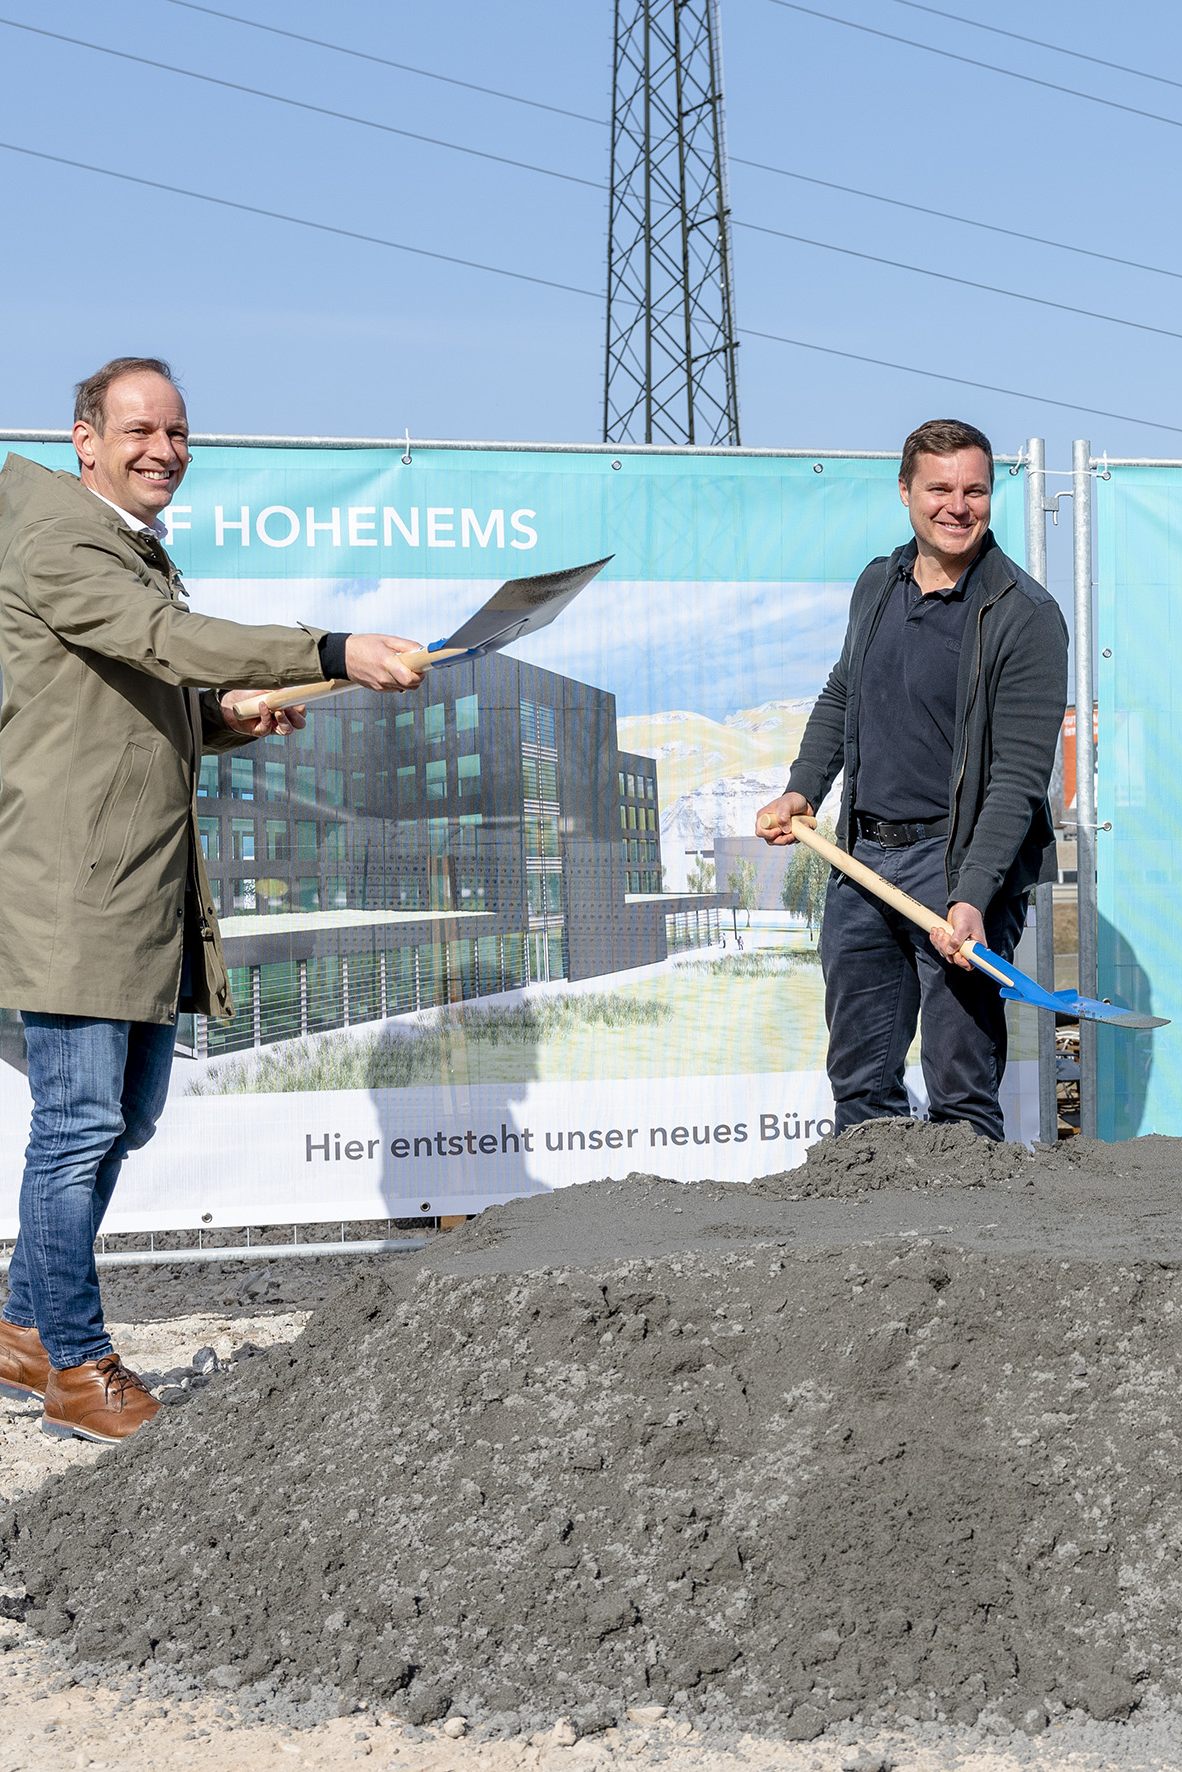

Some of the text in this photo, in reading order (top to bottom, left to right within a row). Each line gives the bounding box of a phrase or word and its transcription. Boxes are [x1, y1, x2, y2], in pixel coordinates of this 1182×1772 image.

[214, 503, 539, 550] HOHENEMS
[305, 1134, 380, 1162] Hier
[390, 1123, 534, 1159] entsteht
[545, 1128, 639, 1152] unser
[650, 1123, 748, 1147] neues
